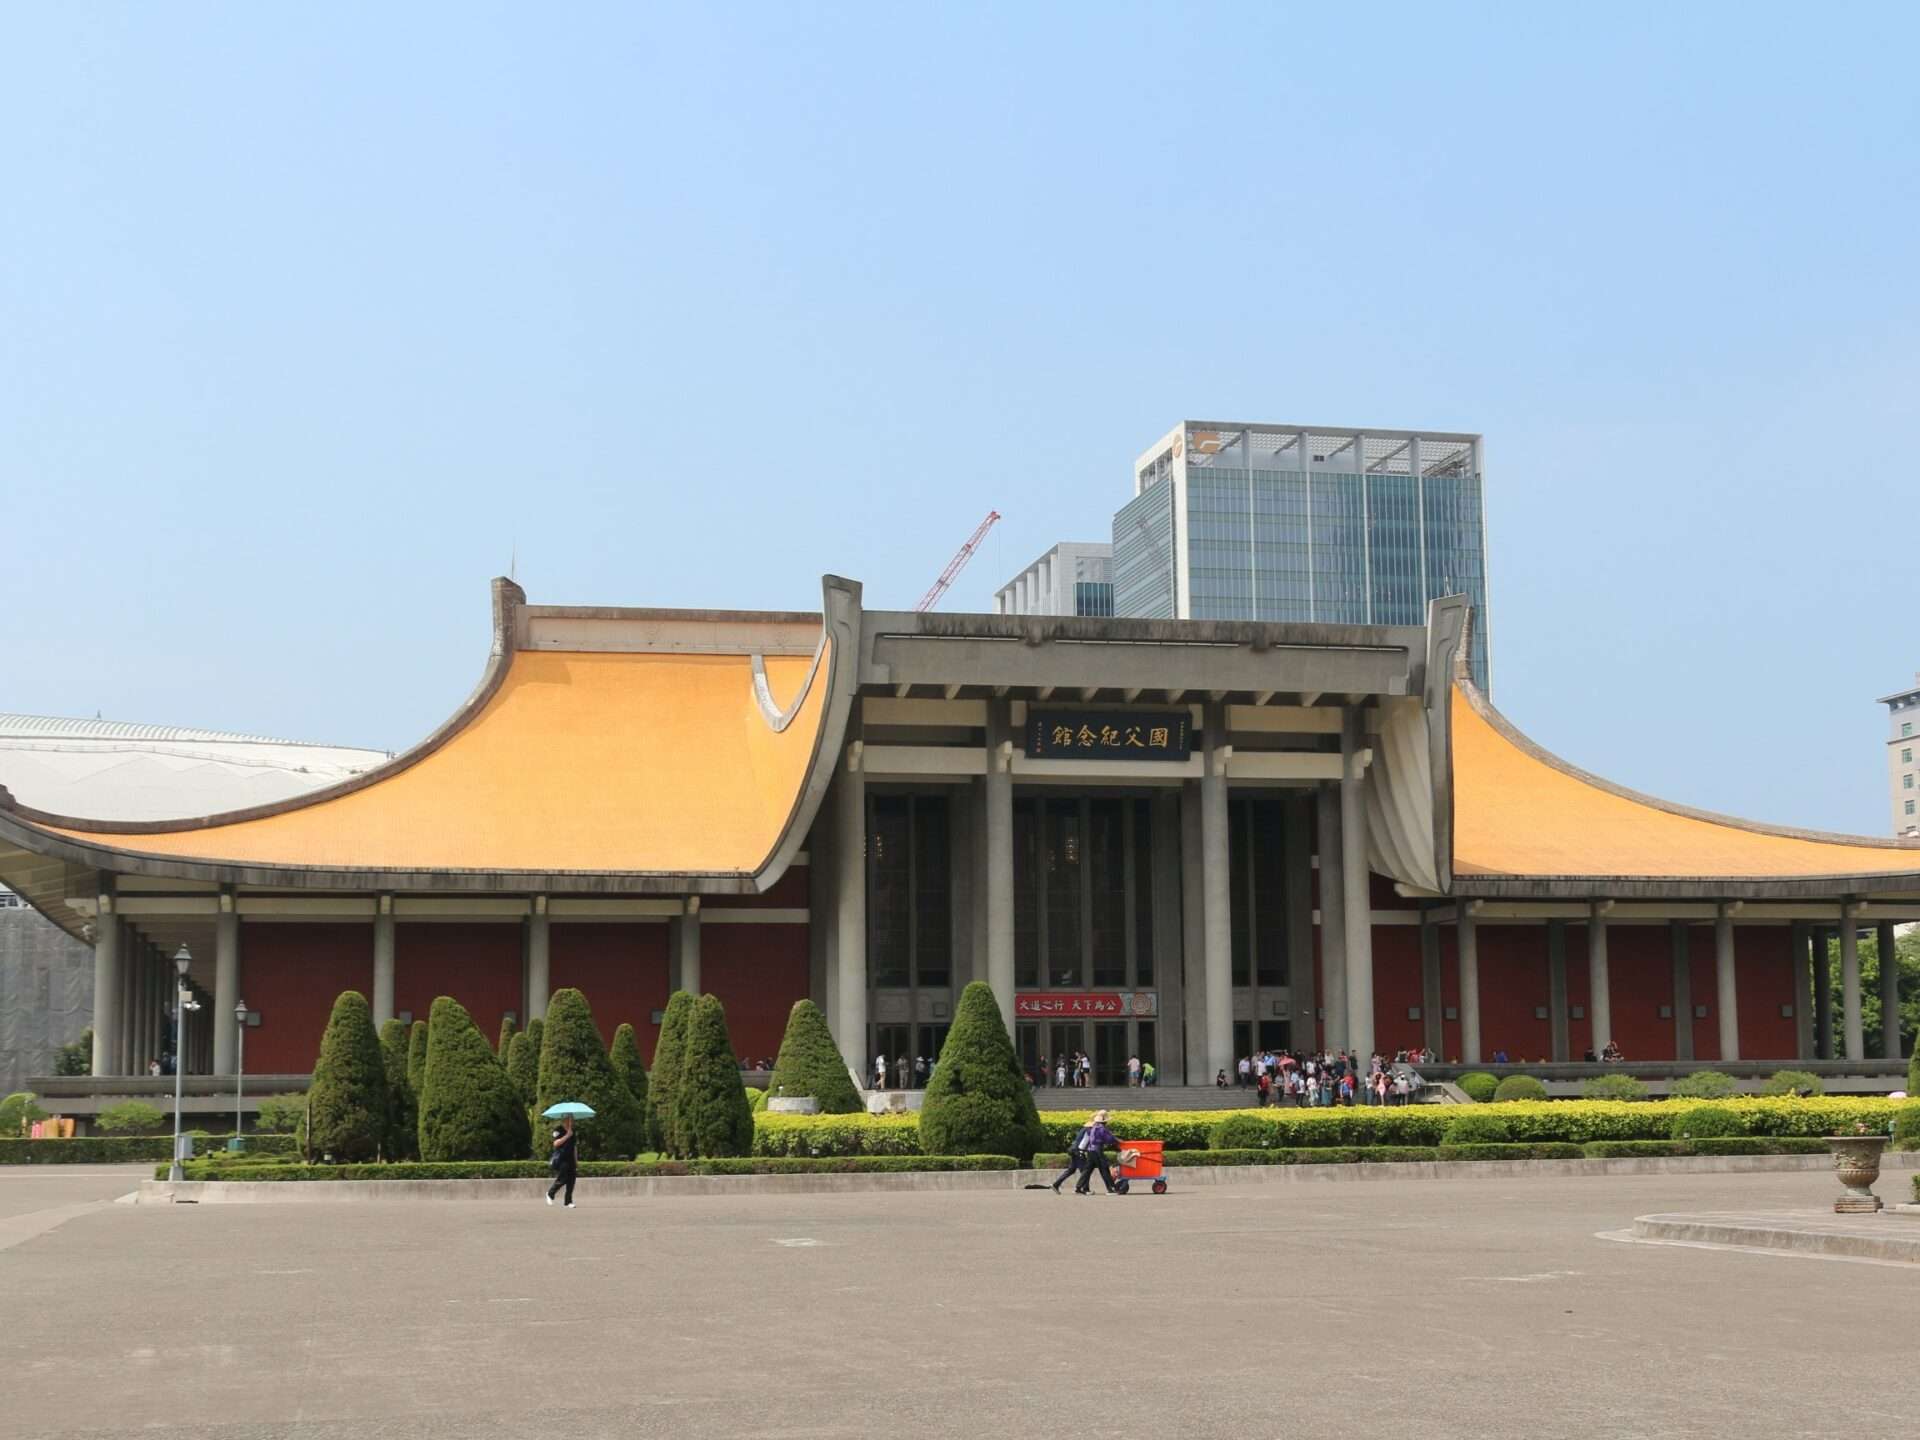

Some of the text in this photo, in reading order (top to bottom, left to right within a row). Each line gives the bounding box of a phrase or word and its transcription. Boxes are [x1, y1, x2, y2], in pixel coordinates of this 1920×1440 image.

[1051, 724, 1169, 748] 國父紀念館
